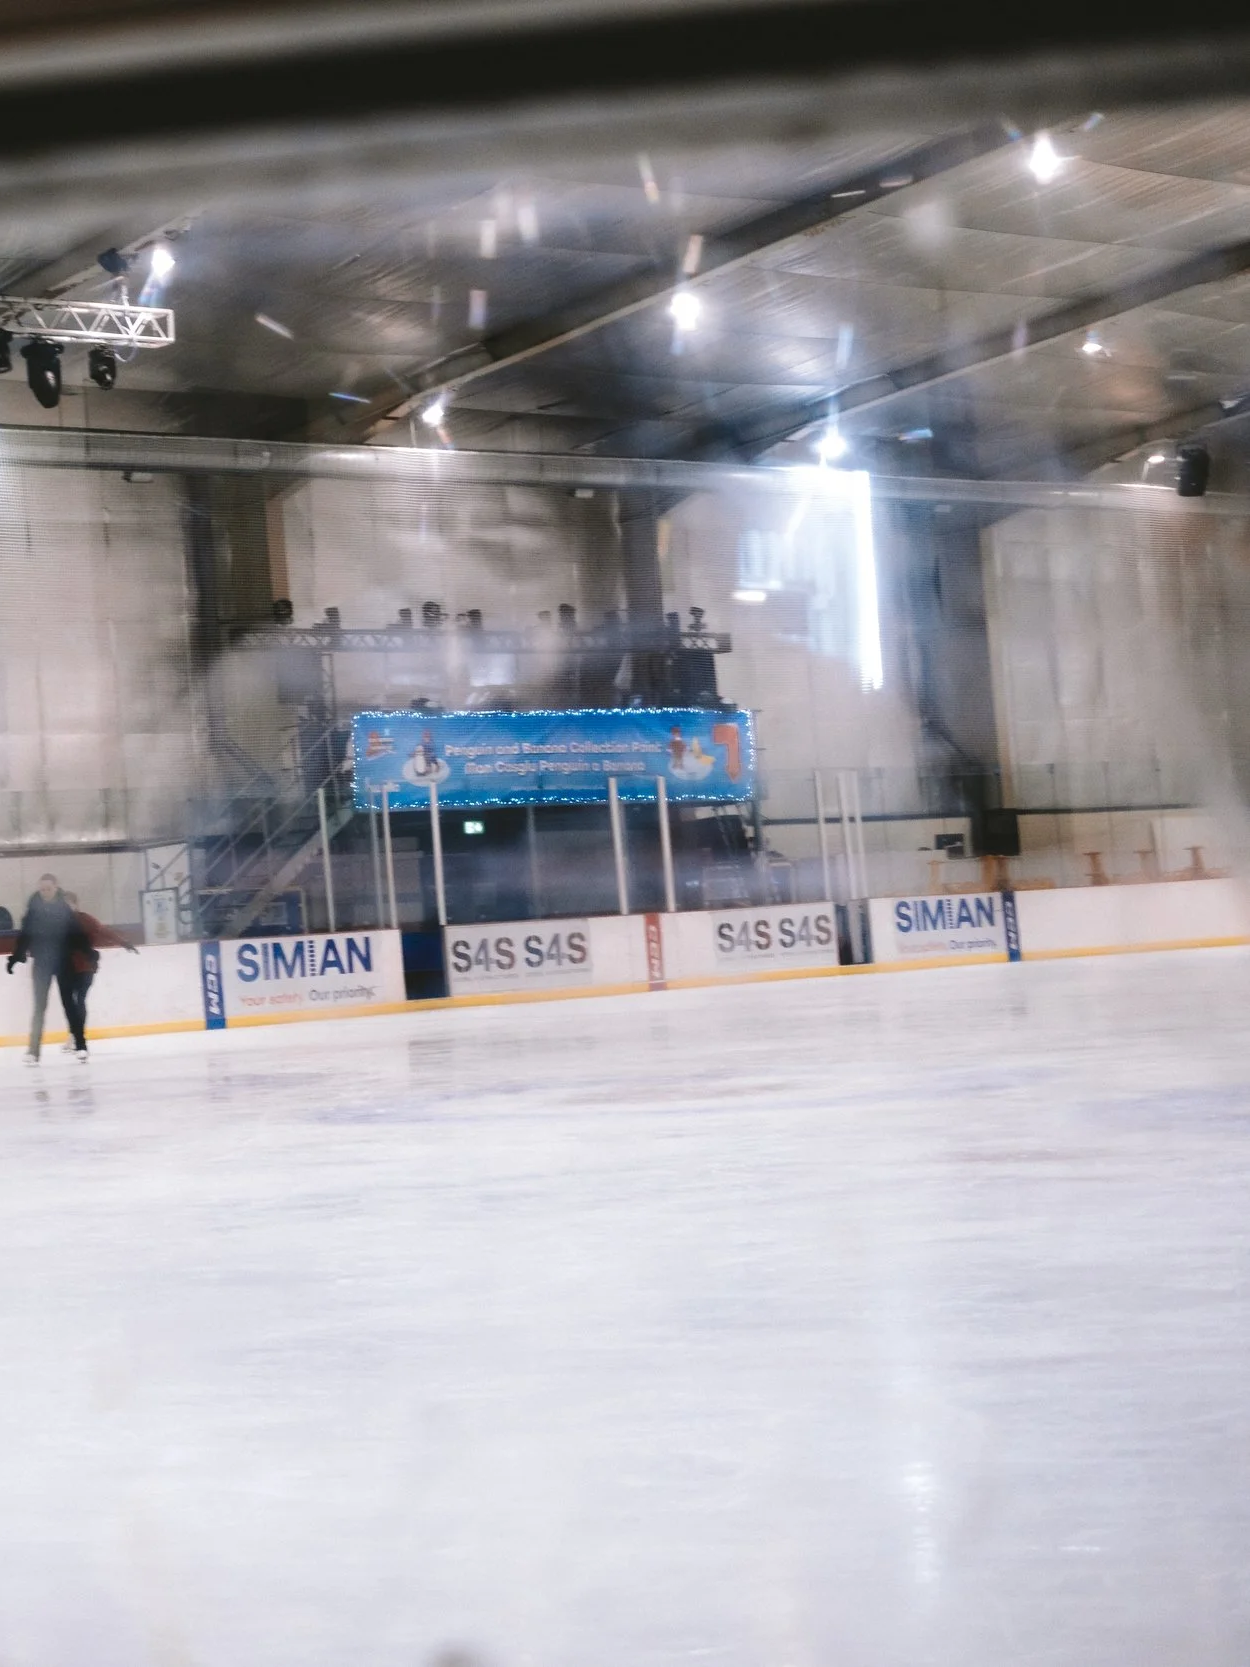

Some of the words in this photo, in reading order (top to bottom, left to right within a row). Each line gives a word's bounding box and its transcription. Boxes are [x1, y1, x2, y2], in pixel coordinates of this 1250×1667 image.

[445, 743, 494, 758] Penguin
[496, 743, 519, 754] and
[522, 743, 566, 754] Banana
[569, 741, 628, 753] Collection
[539, 760, 589, 775] Penguin
[602, 759, 647, 772] Banana
[895, 897, 995, 933] SIMIAN
[717, 919, 772, 953] S4S
[779, 914, 833, 949] S4S
[237, 936, 372, 983] SIMIAN
[453, 936, 516, 973] S4S
[524, 931, 587, 969] S4S
[309, 989, 330, 1002] Our
